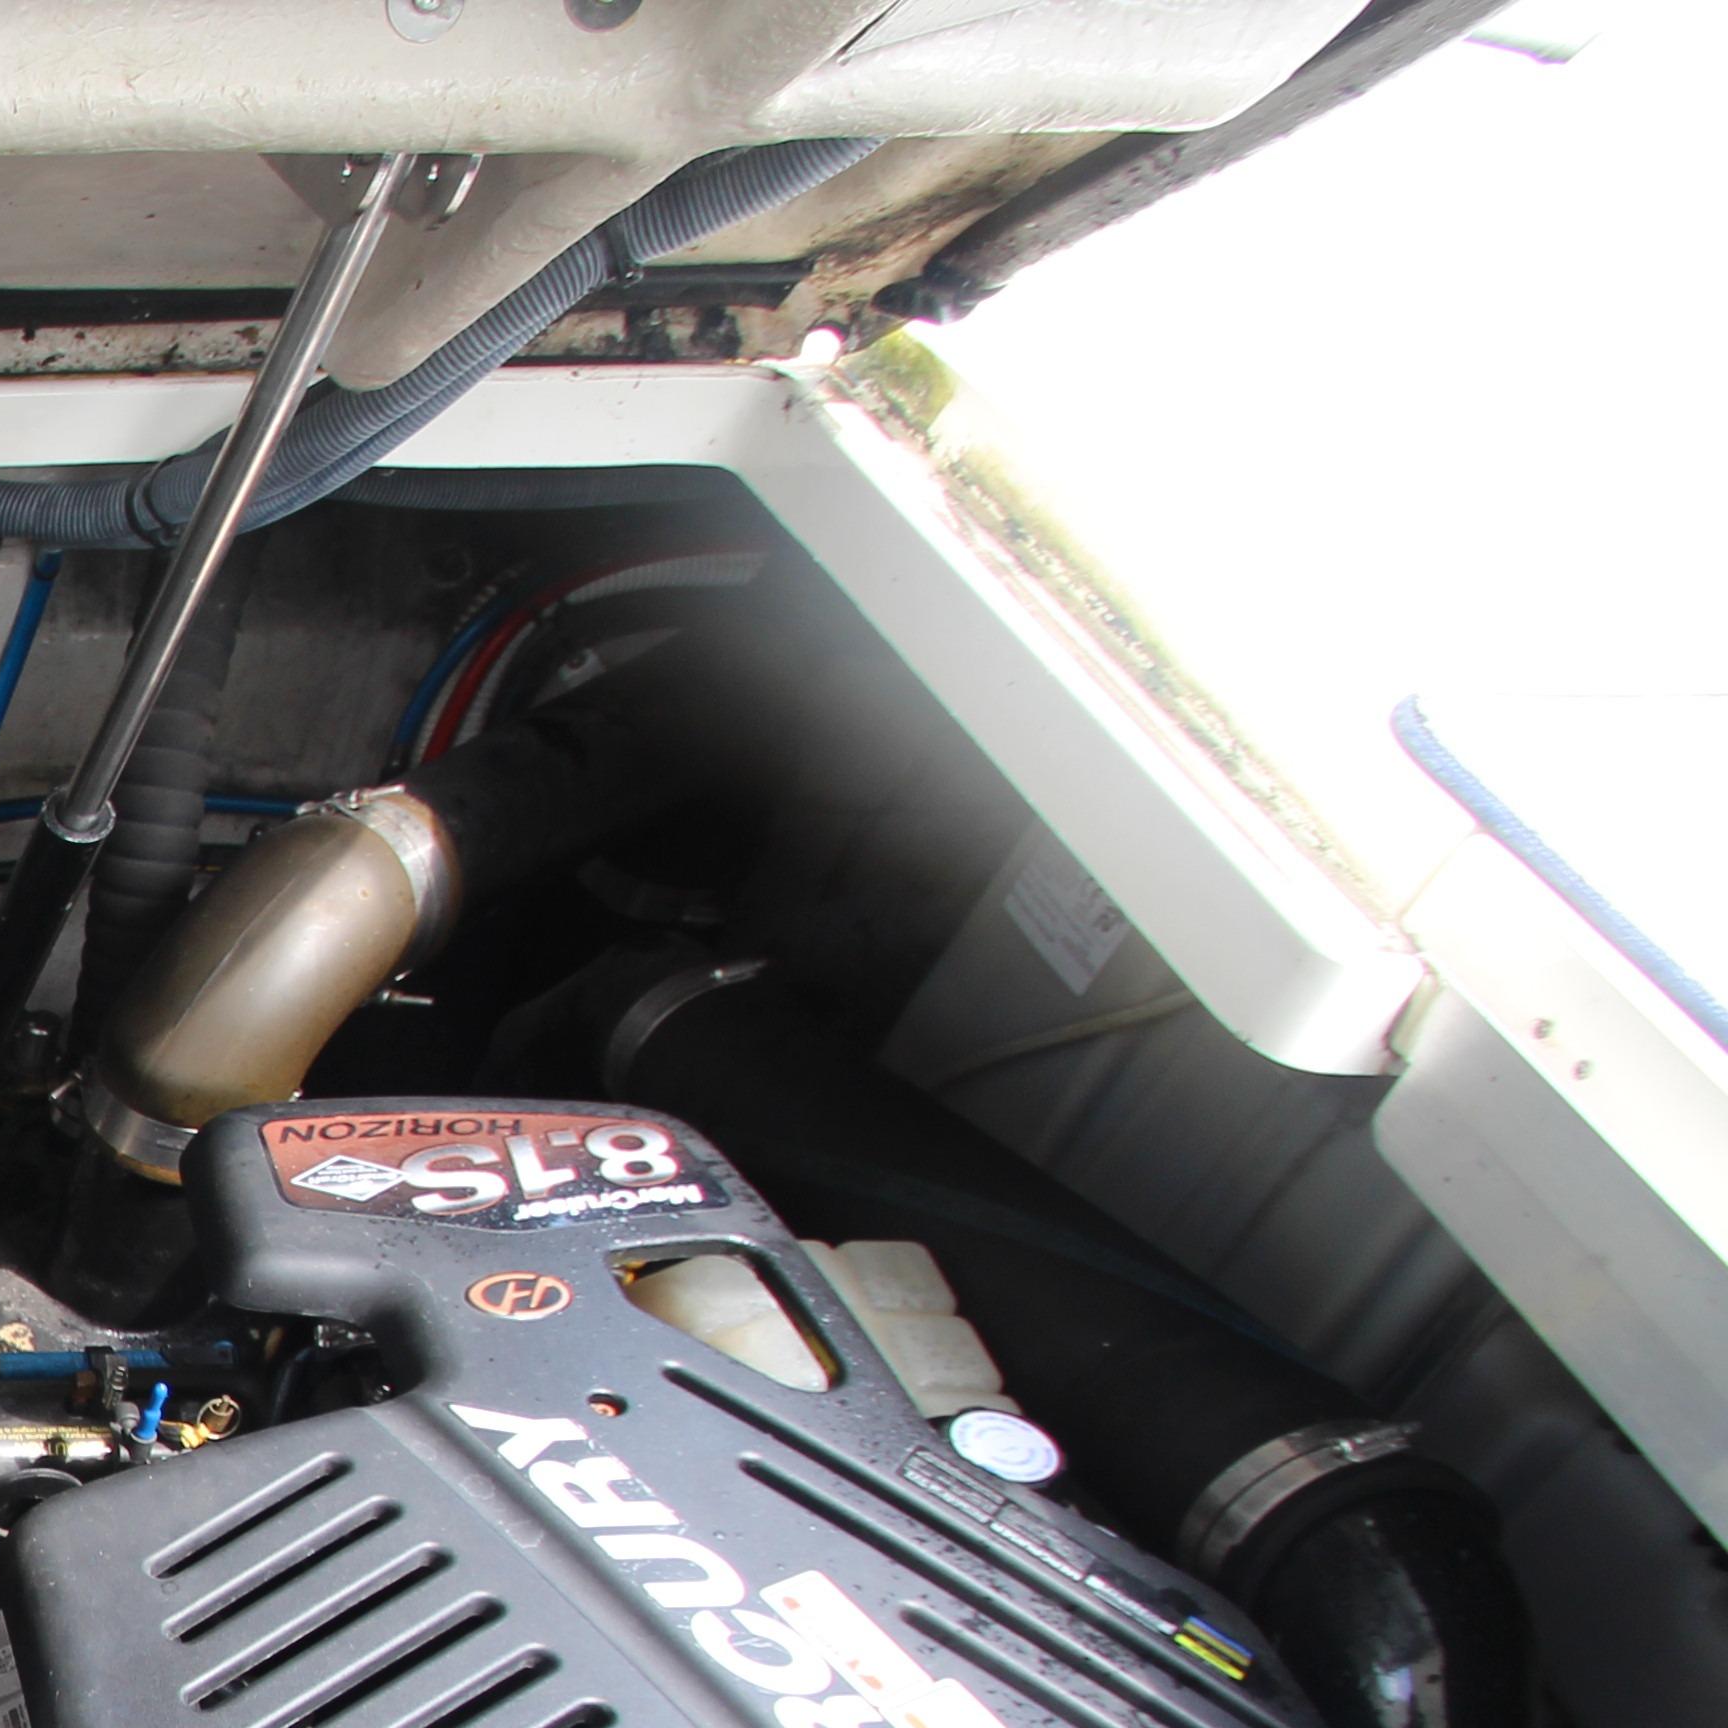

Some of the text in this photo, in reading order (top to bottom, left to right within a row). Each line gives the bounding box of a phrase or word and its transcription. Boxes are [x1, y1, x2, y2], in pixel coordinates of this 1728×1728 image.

[280, 1117, 522, 1144] HORIZON
[402, 1121, 679, 1215] 8.1S
[513, 1184, 702, 1222] MerCruiser
